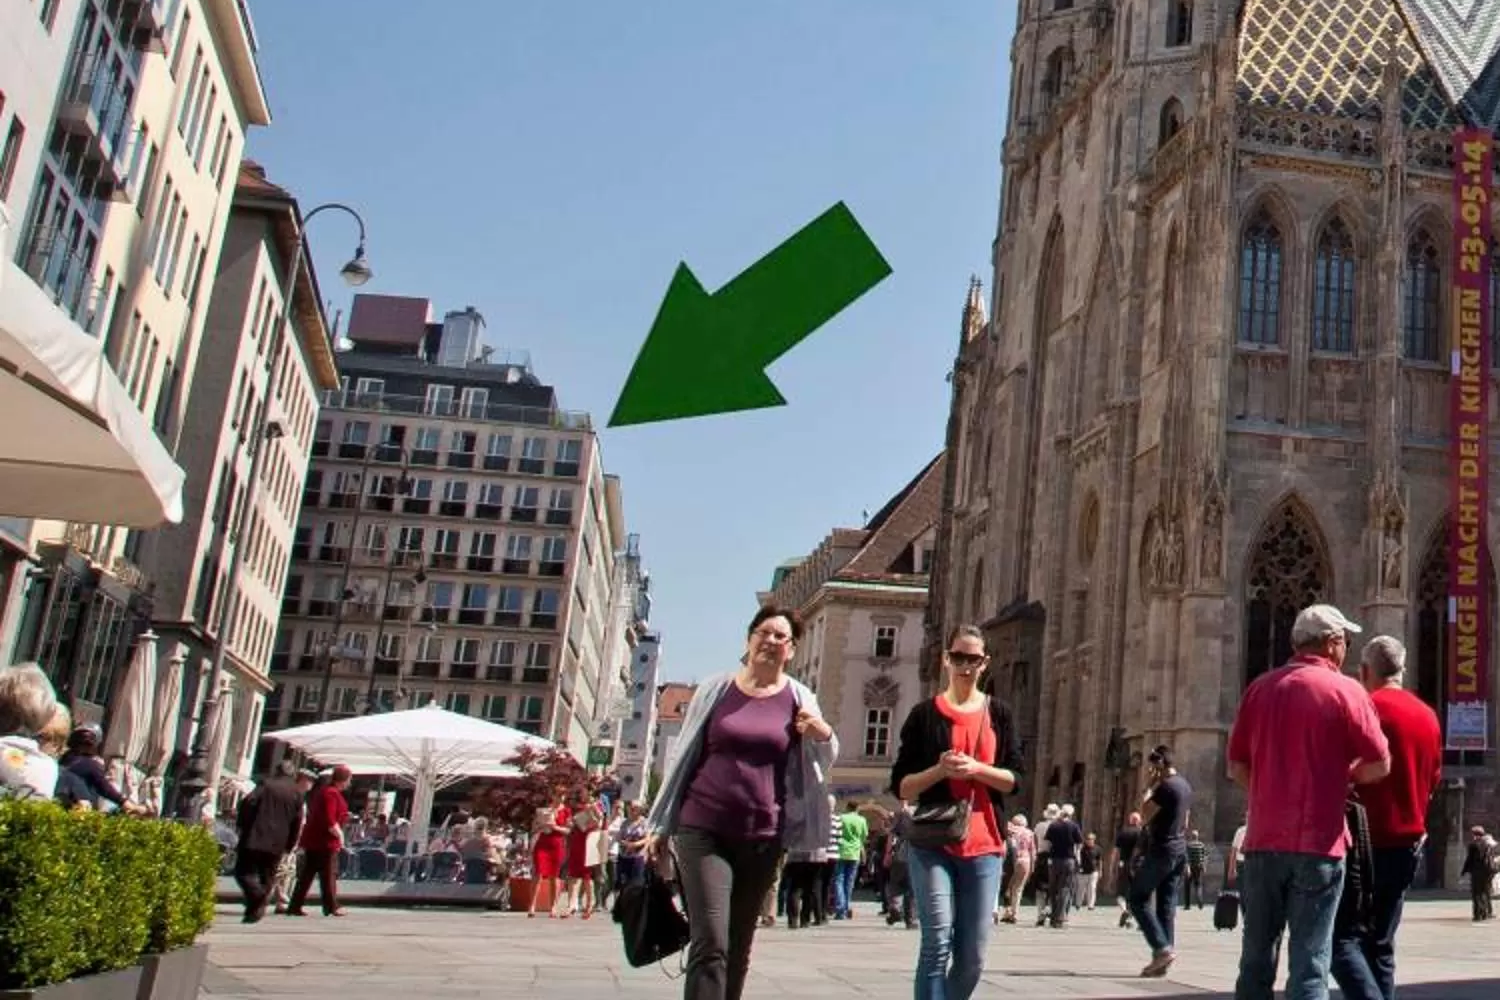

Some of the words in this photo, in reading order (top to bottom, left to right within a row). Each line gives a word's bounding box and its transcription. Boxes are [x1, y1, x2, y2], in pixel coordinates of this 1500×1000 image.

[1460, 139, 1489, 273] 23.05.14
[1460, 289, 1482, 413] KIRCHEN
[1458, 423, 1480, 478] DER
[1457, 484, 1479, 585] NACHT
[1456, 595, 1478, 693] LANGE
